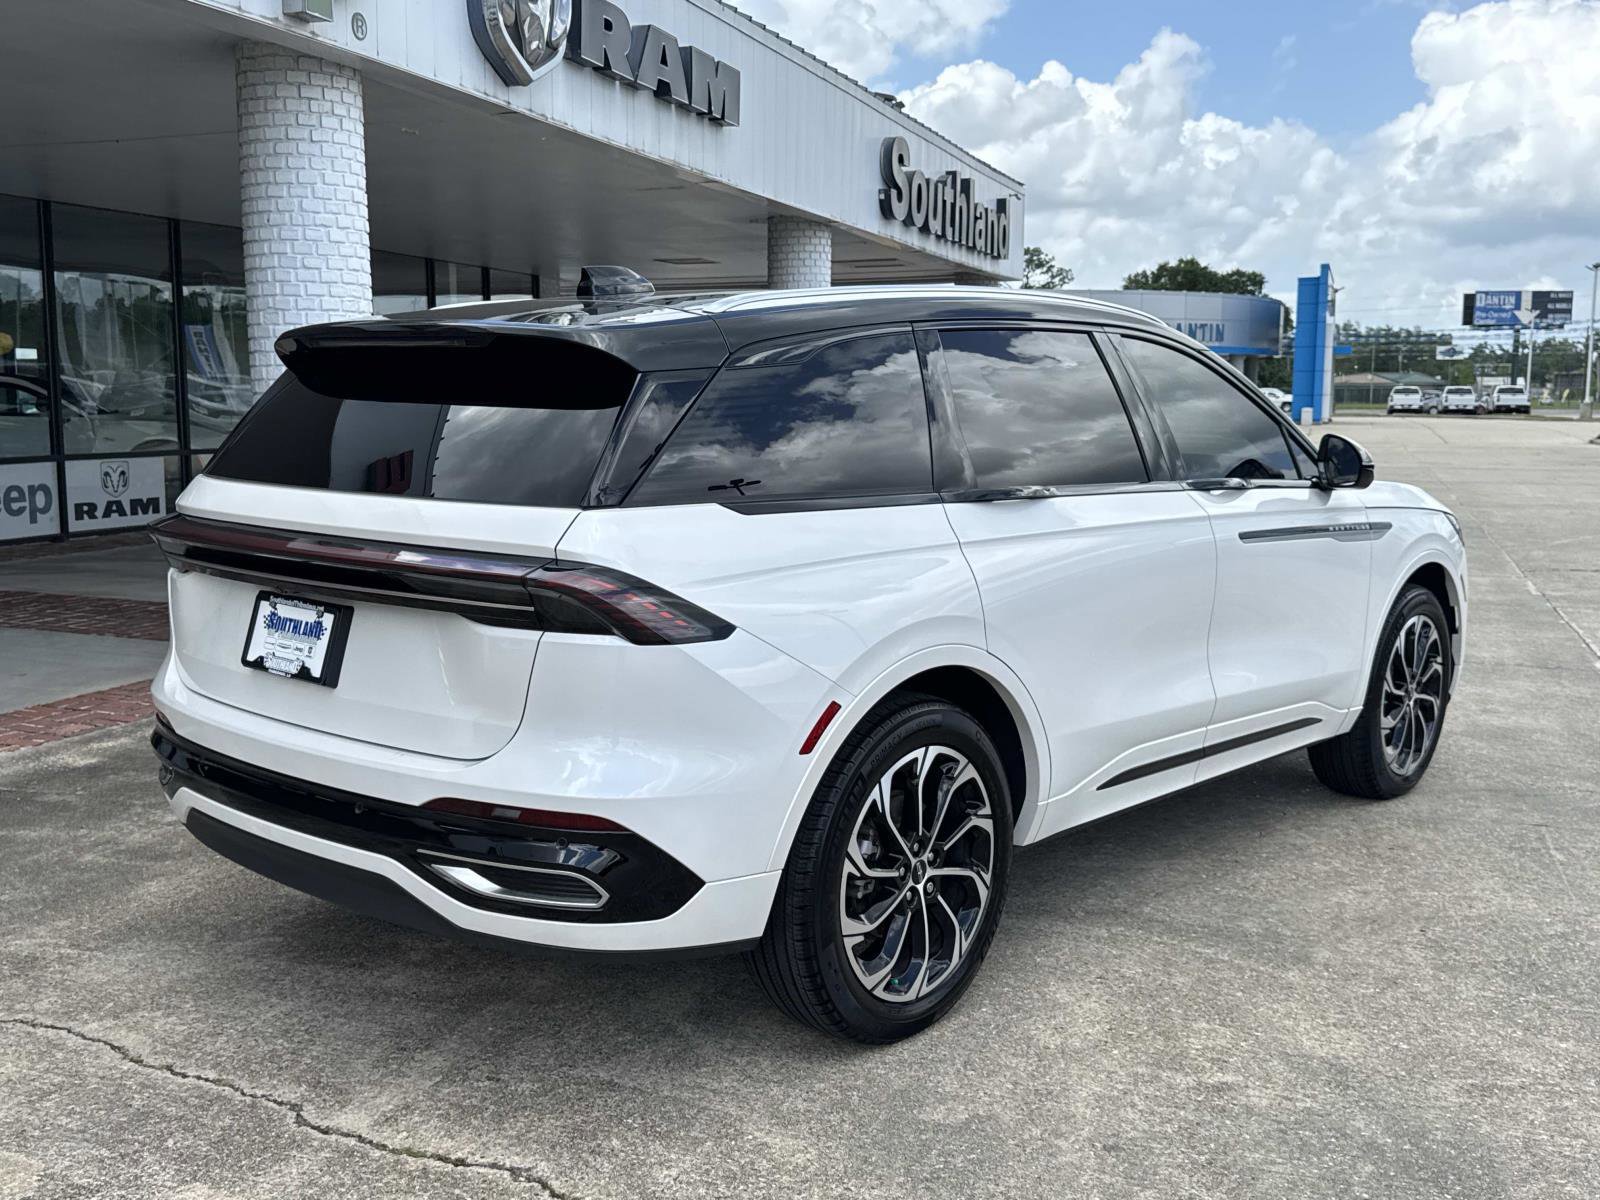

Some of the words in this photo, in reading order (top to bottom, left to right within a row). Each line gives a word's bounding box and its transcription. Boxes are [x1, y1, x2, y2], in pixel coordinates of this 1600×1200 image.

[574, 0, 741, 126] RAM
[882, 136, 1009, 260] Southland
[1176, 322, 1225, 342] ANTIN
[0, 483, 53, 524] ep
[74, 497, 161, 521] RAM
[269, 611, 324, 640] SOUTHLAND
